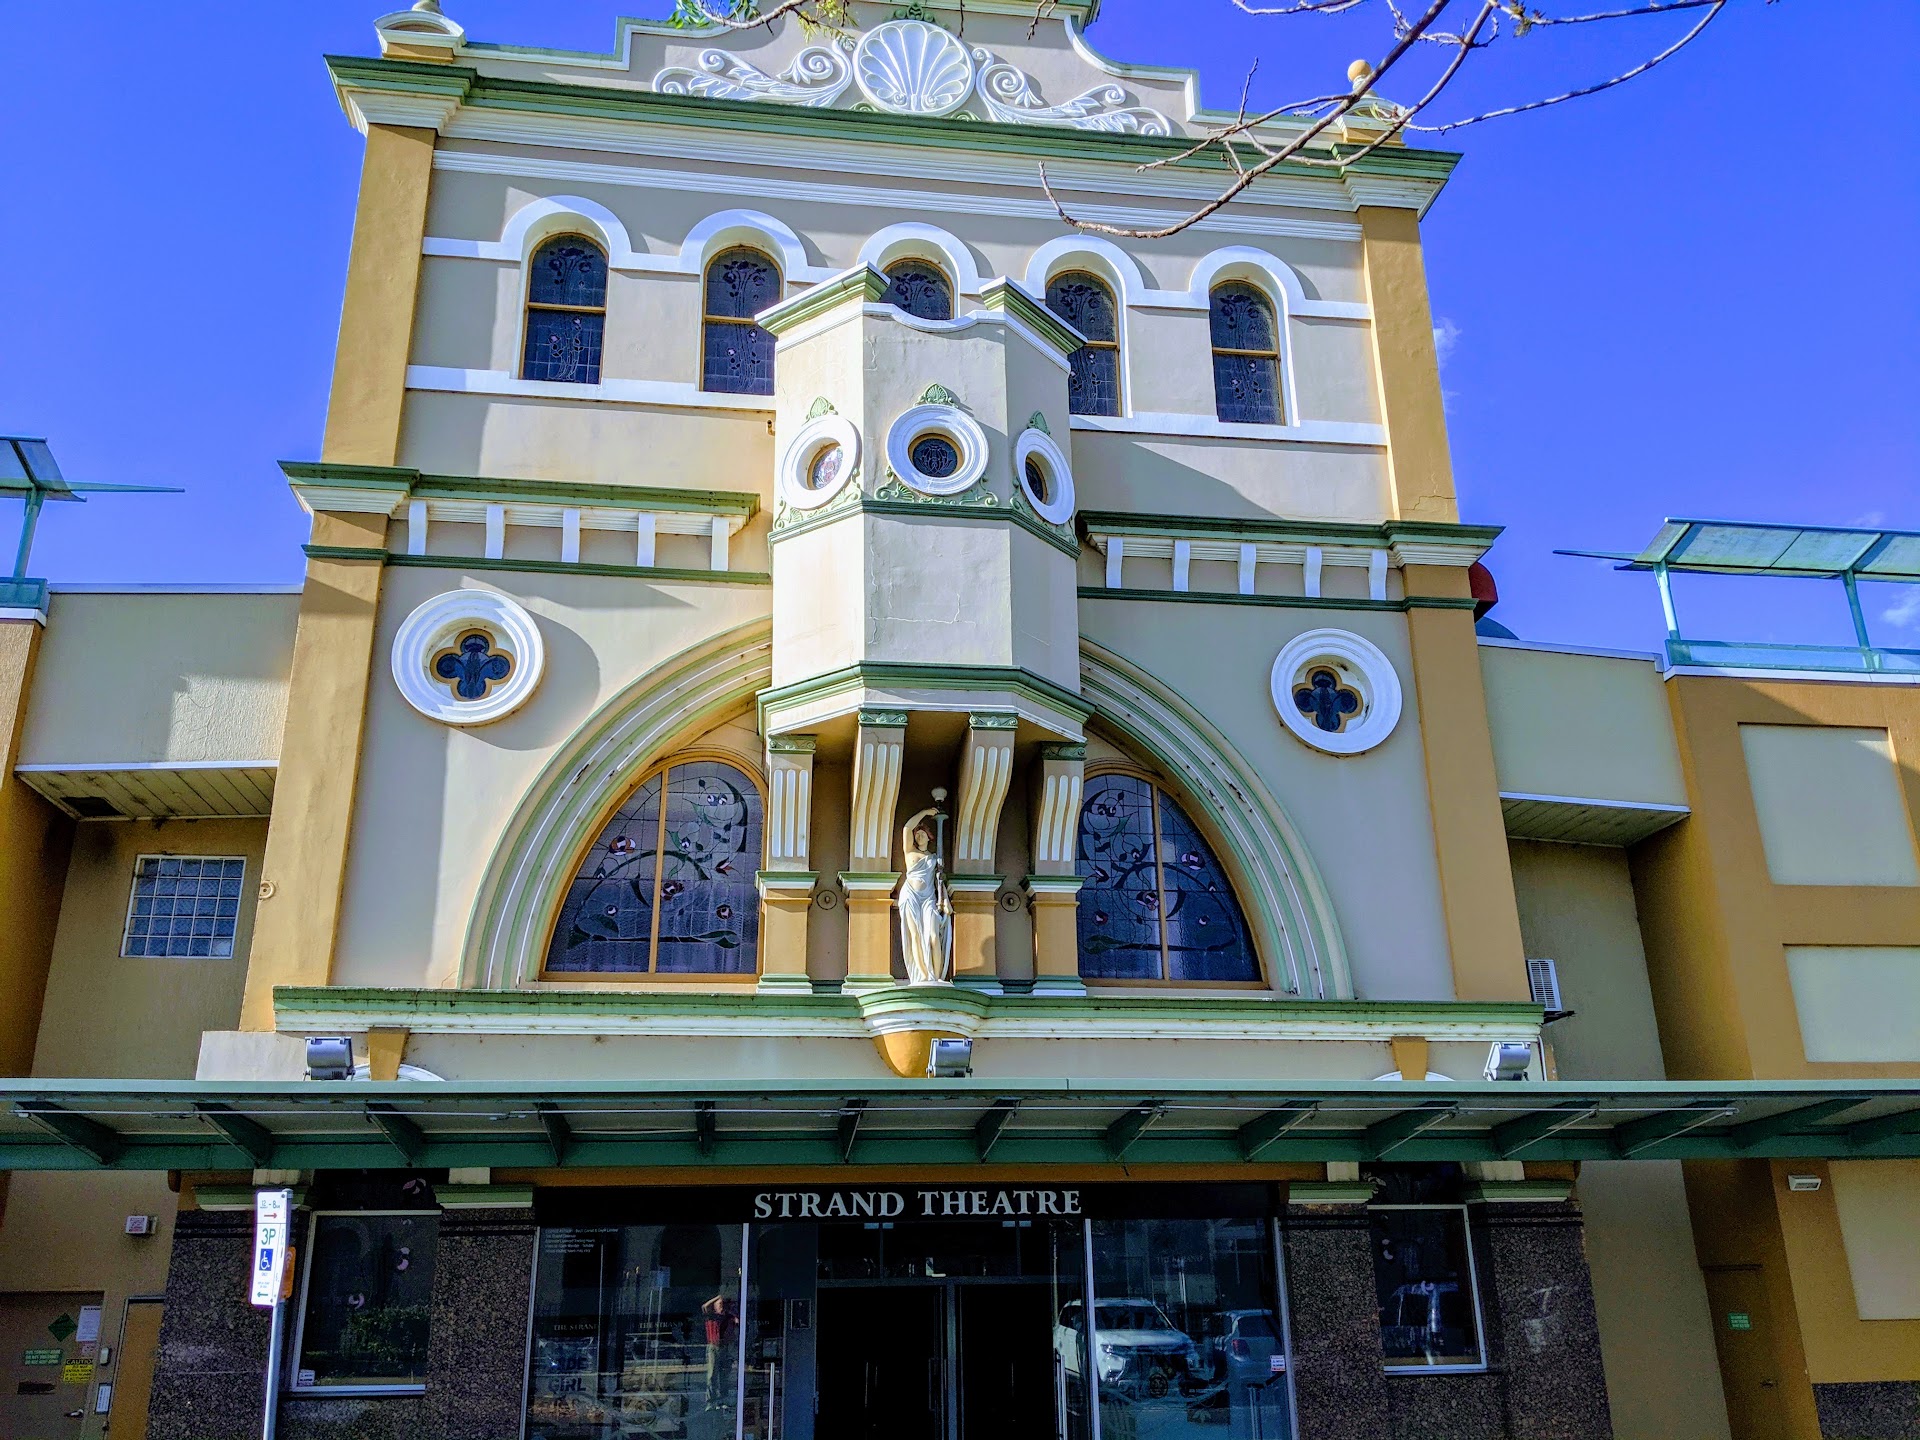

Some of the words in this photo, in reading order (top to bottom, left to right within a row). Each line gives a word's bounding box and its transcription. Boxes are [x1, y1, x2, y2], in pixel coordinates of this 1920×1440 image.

[754, 1192, 905, 1218] STRAND
[917, 1190, 1082, 1216] THEATRE
[261, 1228, 276, 1245] 3P
[548, 1377, 587, 1393] GIRL
